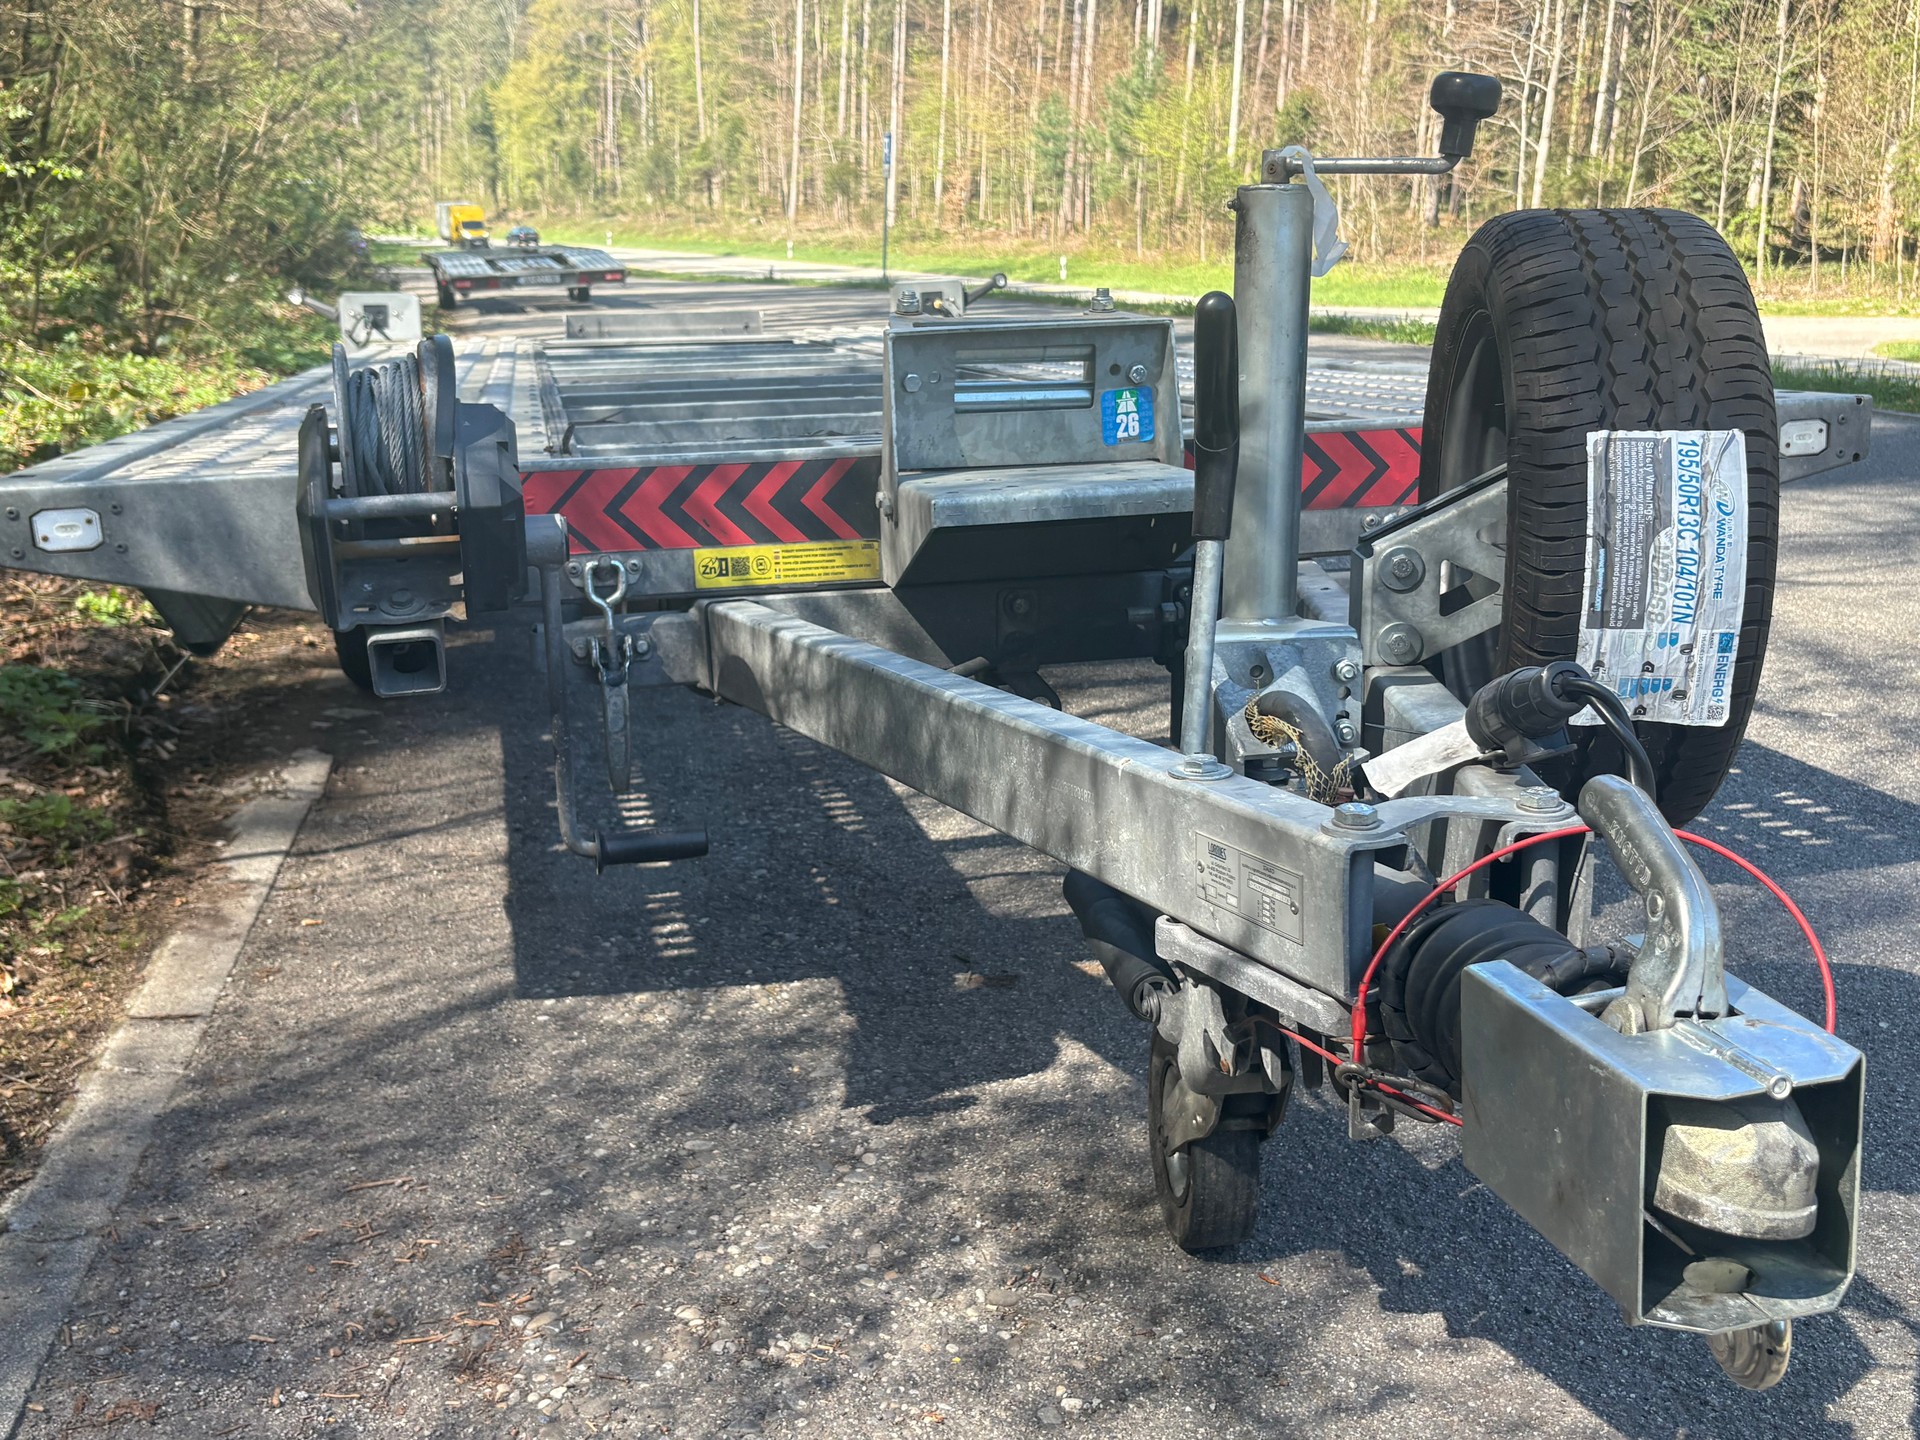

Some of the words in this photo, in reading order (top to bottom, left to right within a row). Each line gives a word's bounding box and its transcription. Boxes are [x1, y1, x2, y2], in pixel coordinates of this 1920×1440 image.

[1116, 413, 1139, 438] 26
[1644, 441, 1654, 472] Safety
[1644, 474, 1654, 524] Warnings:
[1677, 440, 1700, 541] 195/50R13C
[1715, 518, 1726, 563] WANDA
[701, 564, 717, 575] Zn
[1672, 547, 1698, 624] 104/101N
[1713, 566, 1724, 600] TYRE
[1712, 656, 1729, 697] ENERG
[1609, 820, 1645, 874] KNOTT
